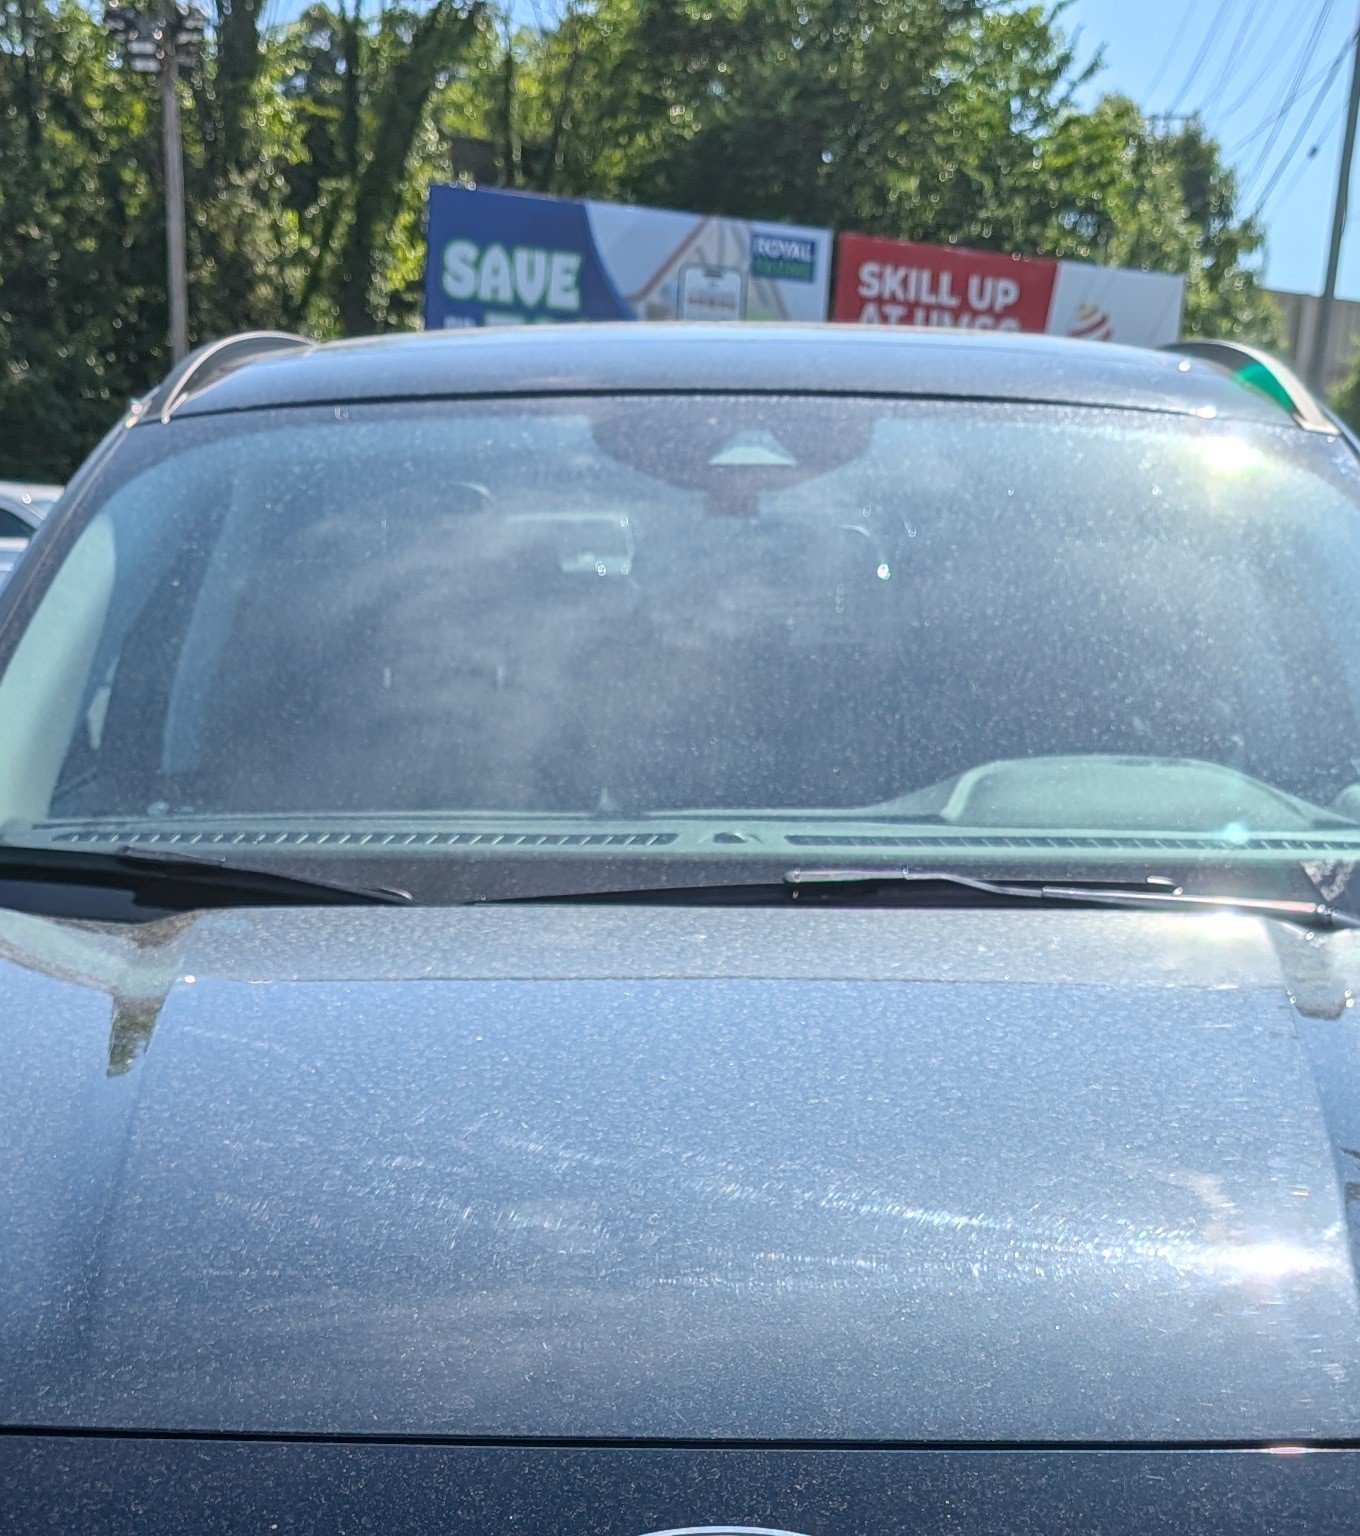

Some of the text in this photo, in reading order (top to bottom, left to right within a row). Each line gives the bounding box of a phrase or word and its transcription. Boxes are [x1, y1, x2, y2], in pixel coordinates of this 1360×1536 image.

[442, 238, 582, 312] SAVE
[858, 262, 961, 309] SKILL
[966, 273, 1020, 315] UP
